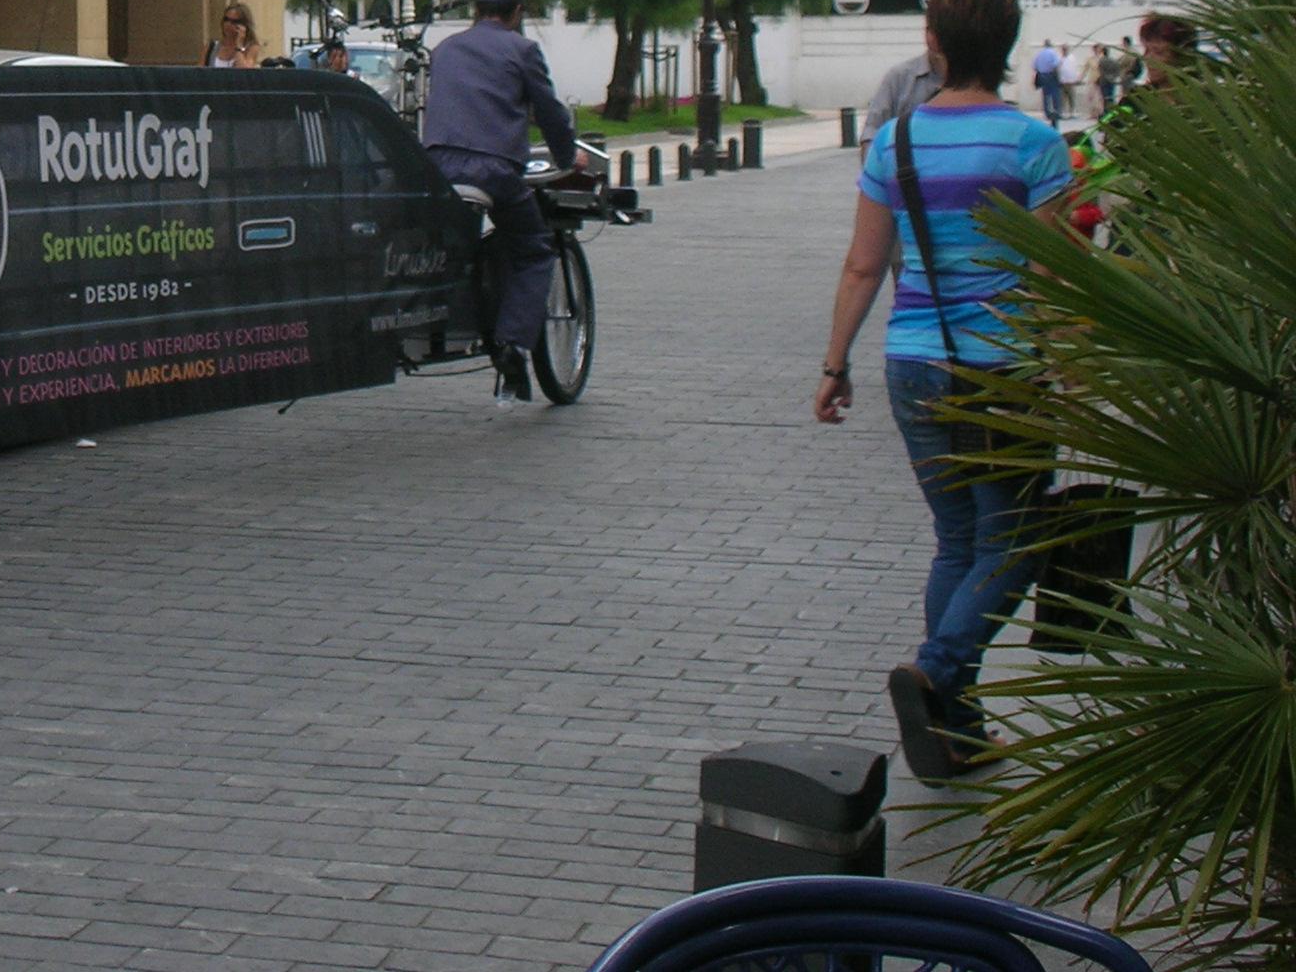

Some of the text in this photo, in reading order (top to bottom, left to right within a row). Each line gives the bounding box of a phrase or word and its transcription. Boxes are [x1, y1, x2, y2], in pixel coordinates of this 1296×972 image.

[37, 104, 214, 189] RotulGraf
[42, 218, 215, 263] Servicios Gráficos
[84, 282, 139, 305] DESDE
[141, 278, 180, 303] 1982
[1, 357, 15, 377] Y
[19, 340, 116, 374] DECORACIÓN
[120, 342, 138, 361] DE
[143, 331, 221, 357] INTERIORES
[235, 320, 310, 345] EXTERIORES
[2, 386, 16, 407] Y
[125, 358, 216, 389] MARCAMOS
[218, 355, 236, 376] LA
[238, 345, 312, 372] DIFERENCIA
